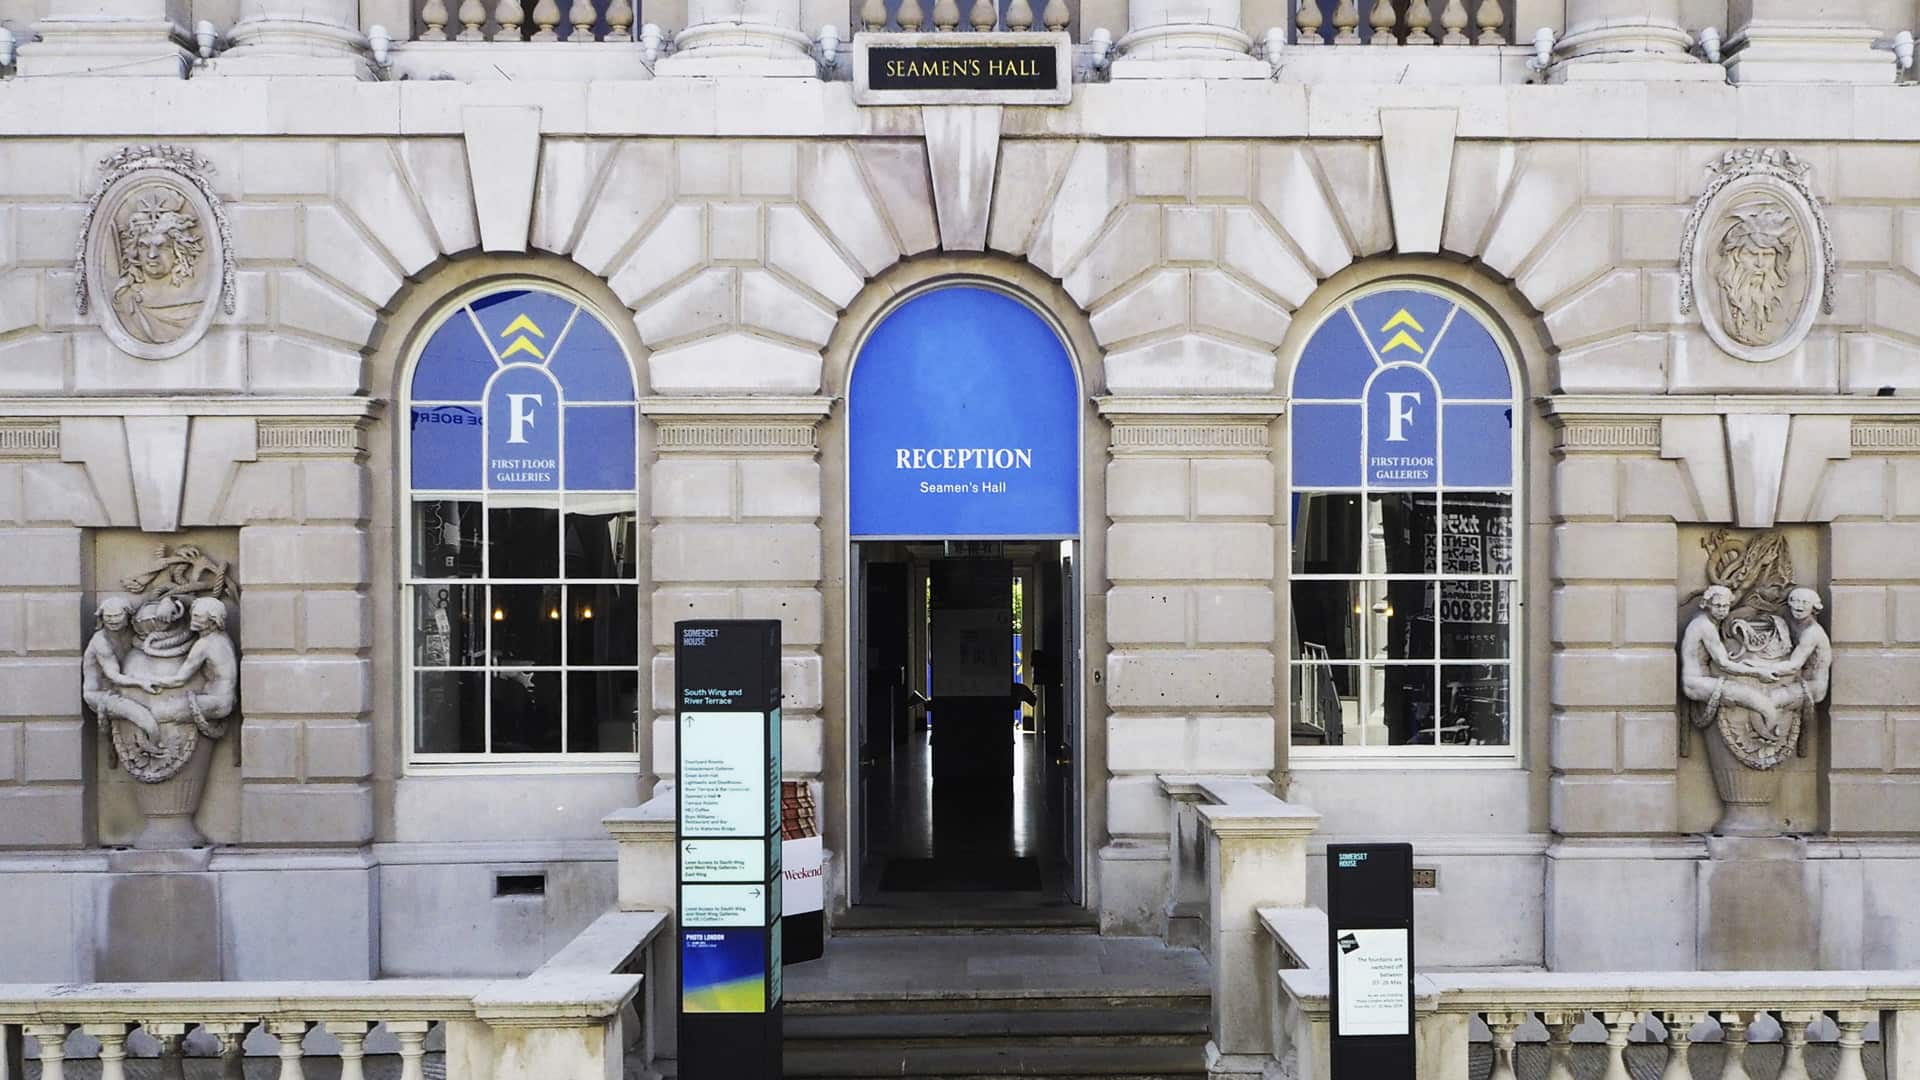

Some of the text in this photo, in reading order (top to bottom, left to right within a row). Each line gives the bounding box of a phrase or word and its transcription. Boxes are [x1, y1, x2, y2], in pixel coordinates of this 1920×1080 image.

[886, 59, 1040, 77] SEAMEN'S HALL
[506, 393, 544, 444] F
[1384, 392, 1421, 442] F
[896, 448, 1032, 469] RECEPTION
[1371, 456, 1434, 466] FIRST FLOOR
[492, 460, 556, 469] FIRST FLOOR
[496, 472, 551, 482] GALLERIES
[1376, 470, 1429, 480] GALLERIES
[920, 482, 1006, 494] Seamen's Hall
[683, 629, 719, 638] SOMERSET
[683, 638, 706, 646] HOUSE
[684, 688, 742, 698] South Wing and
[784, 864, 822, 880] Weekend
